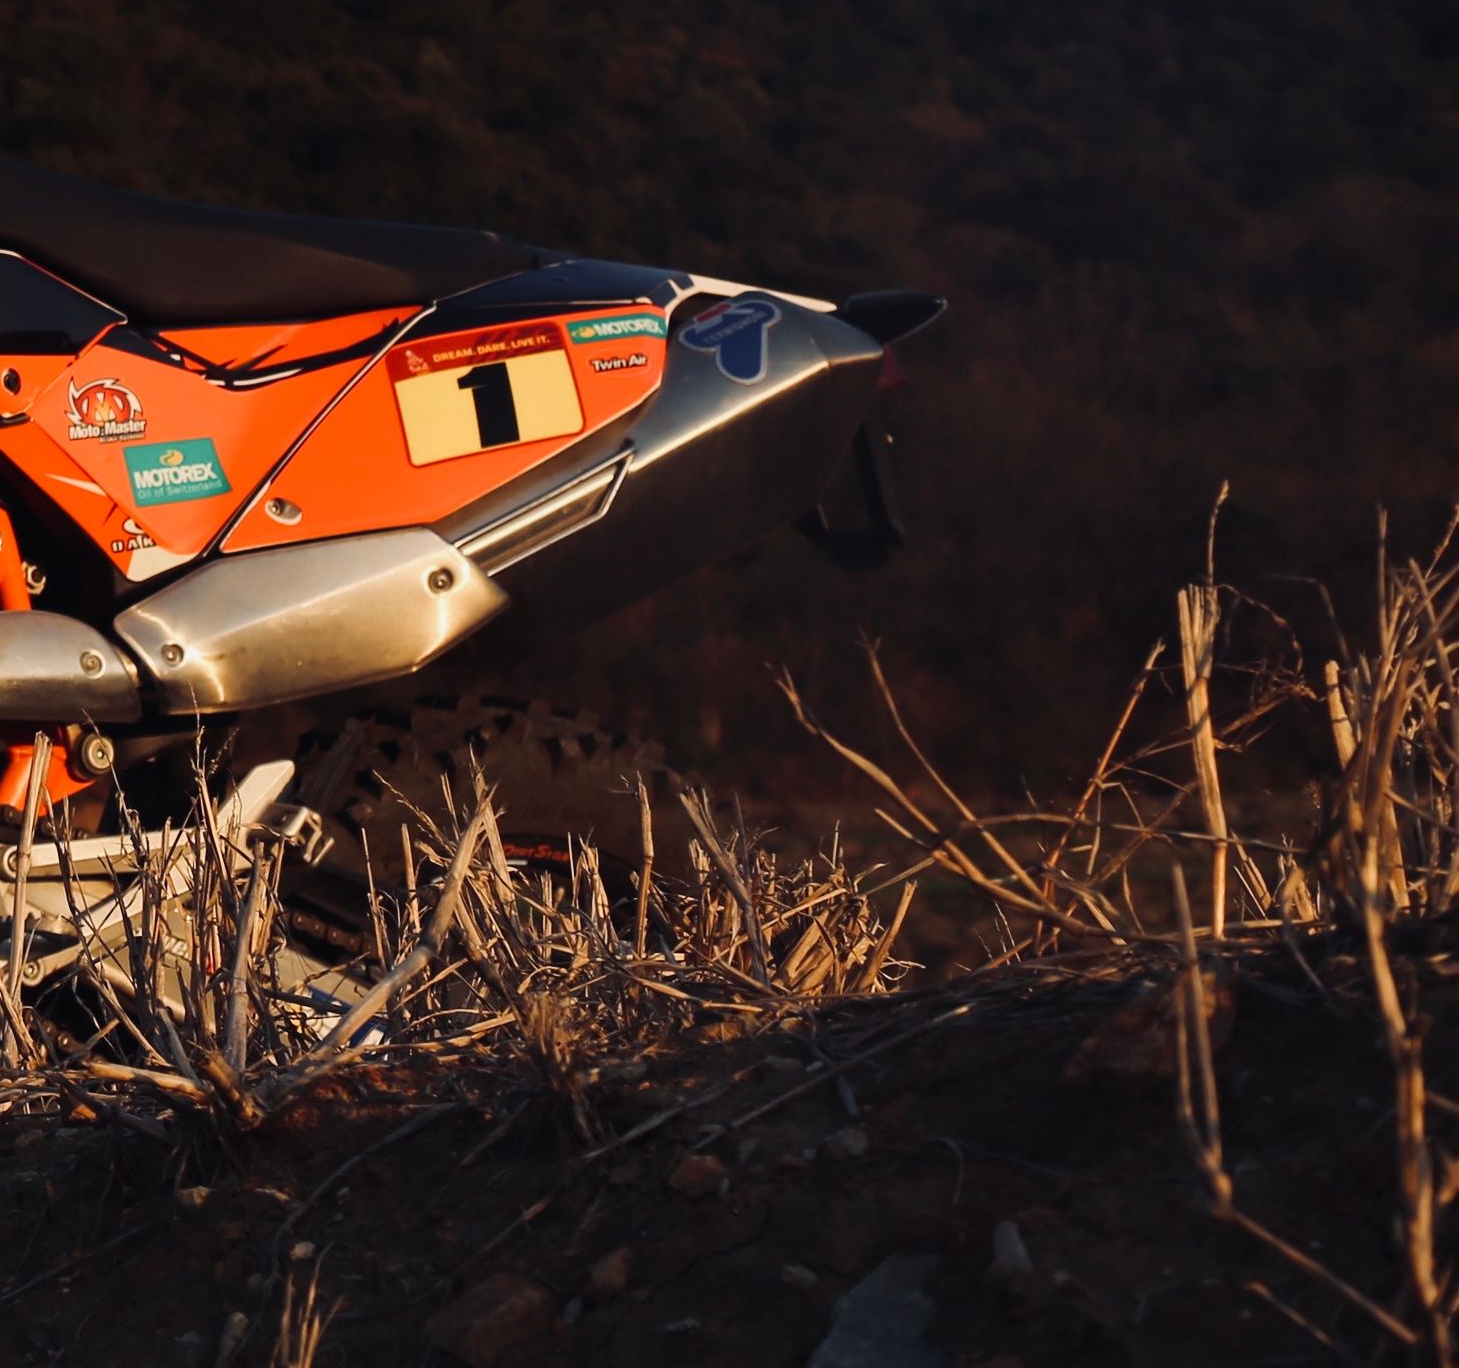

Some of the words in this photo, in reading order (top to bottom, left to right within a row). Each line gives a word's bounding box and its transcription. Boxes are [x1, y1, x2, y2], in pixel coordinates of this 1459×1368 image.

[593, 318, 664, 336] MOTOREX
[433, 347, 477, 363] DREAM.
[477, 341, 511, 355] DARE.
[511, 337, 536, 349] LIVE
[592, 358, 627, 372] Twin
[628, 354, 647, 367] Air
[457, 361, 520, 449] 1
[134, 462, 218, 489] MOTOREX
[138, 488, 152, 500] Oil
[154, 486, 164, 498] of
[166, 479, 223, 496] Switzerland
[110, 534, 157, 553] OAK
